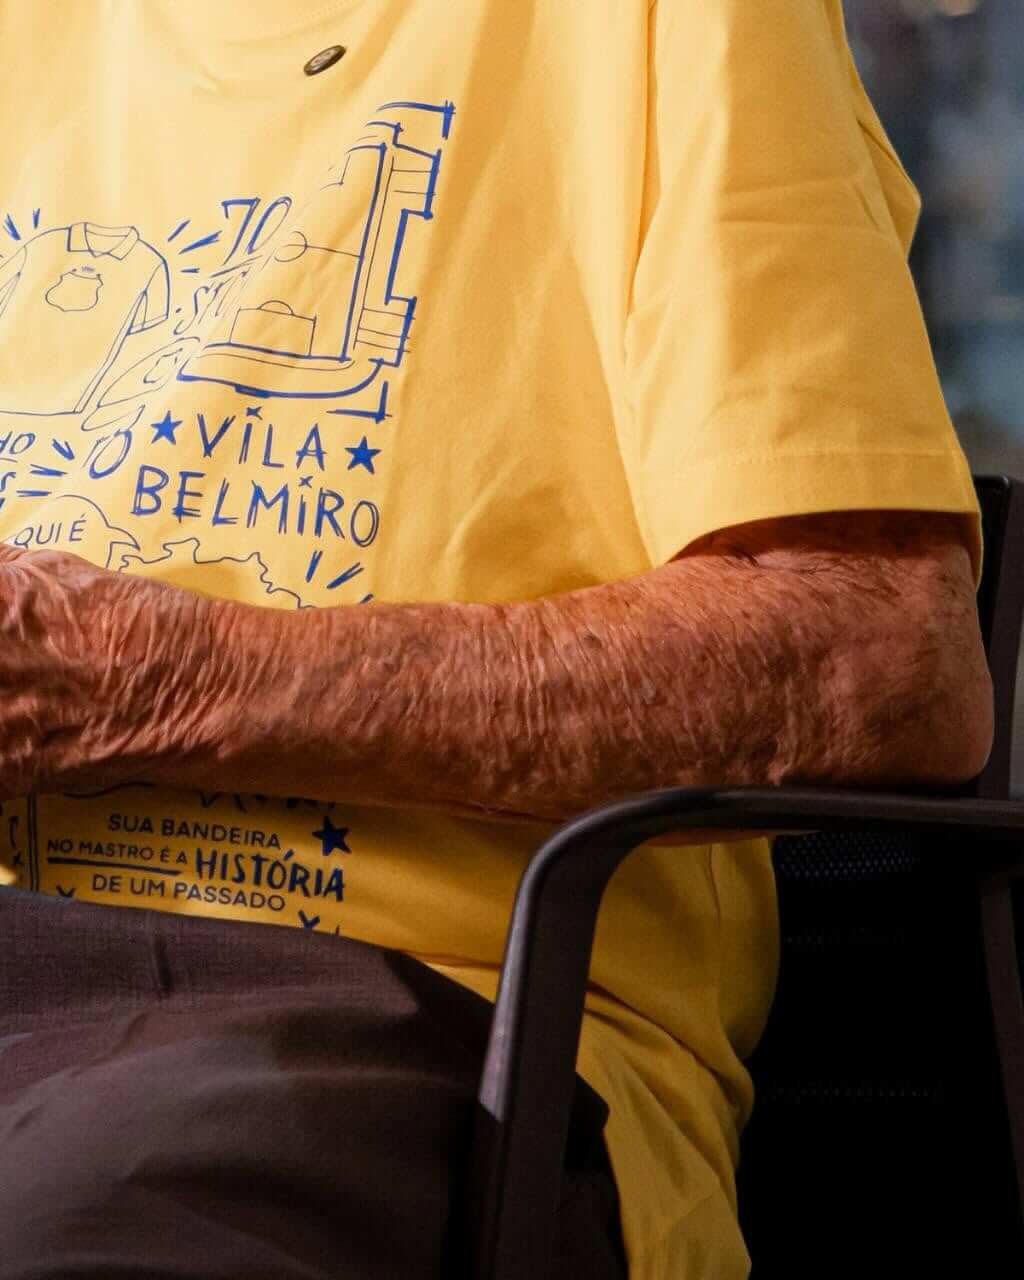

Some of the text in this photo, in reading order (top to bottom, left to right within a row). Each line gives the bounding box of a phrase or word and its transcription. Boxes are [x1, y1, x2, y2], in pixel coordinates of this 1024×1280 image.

[69, 513, 87, 542] É
[107, 813, 282, 851] SUA BANDEIRA
[46, 838, 346, 903] NO MASTRO É A HISTÓRIA
[91, 873, 287, 913] DE UM PASSADO
